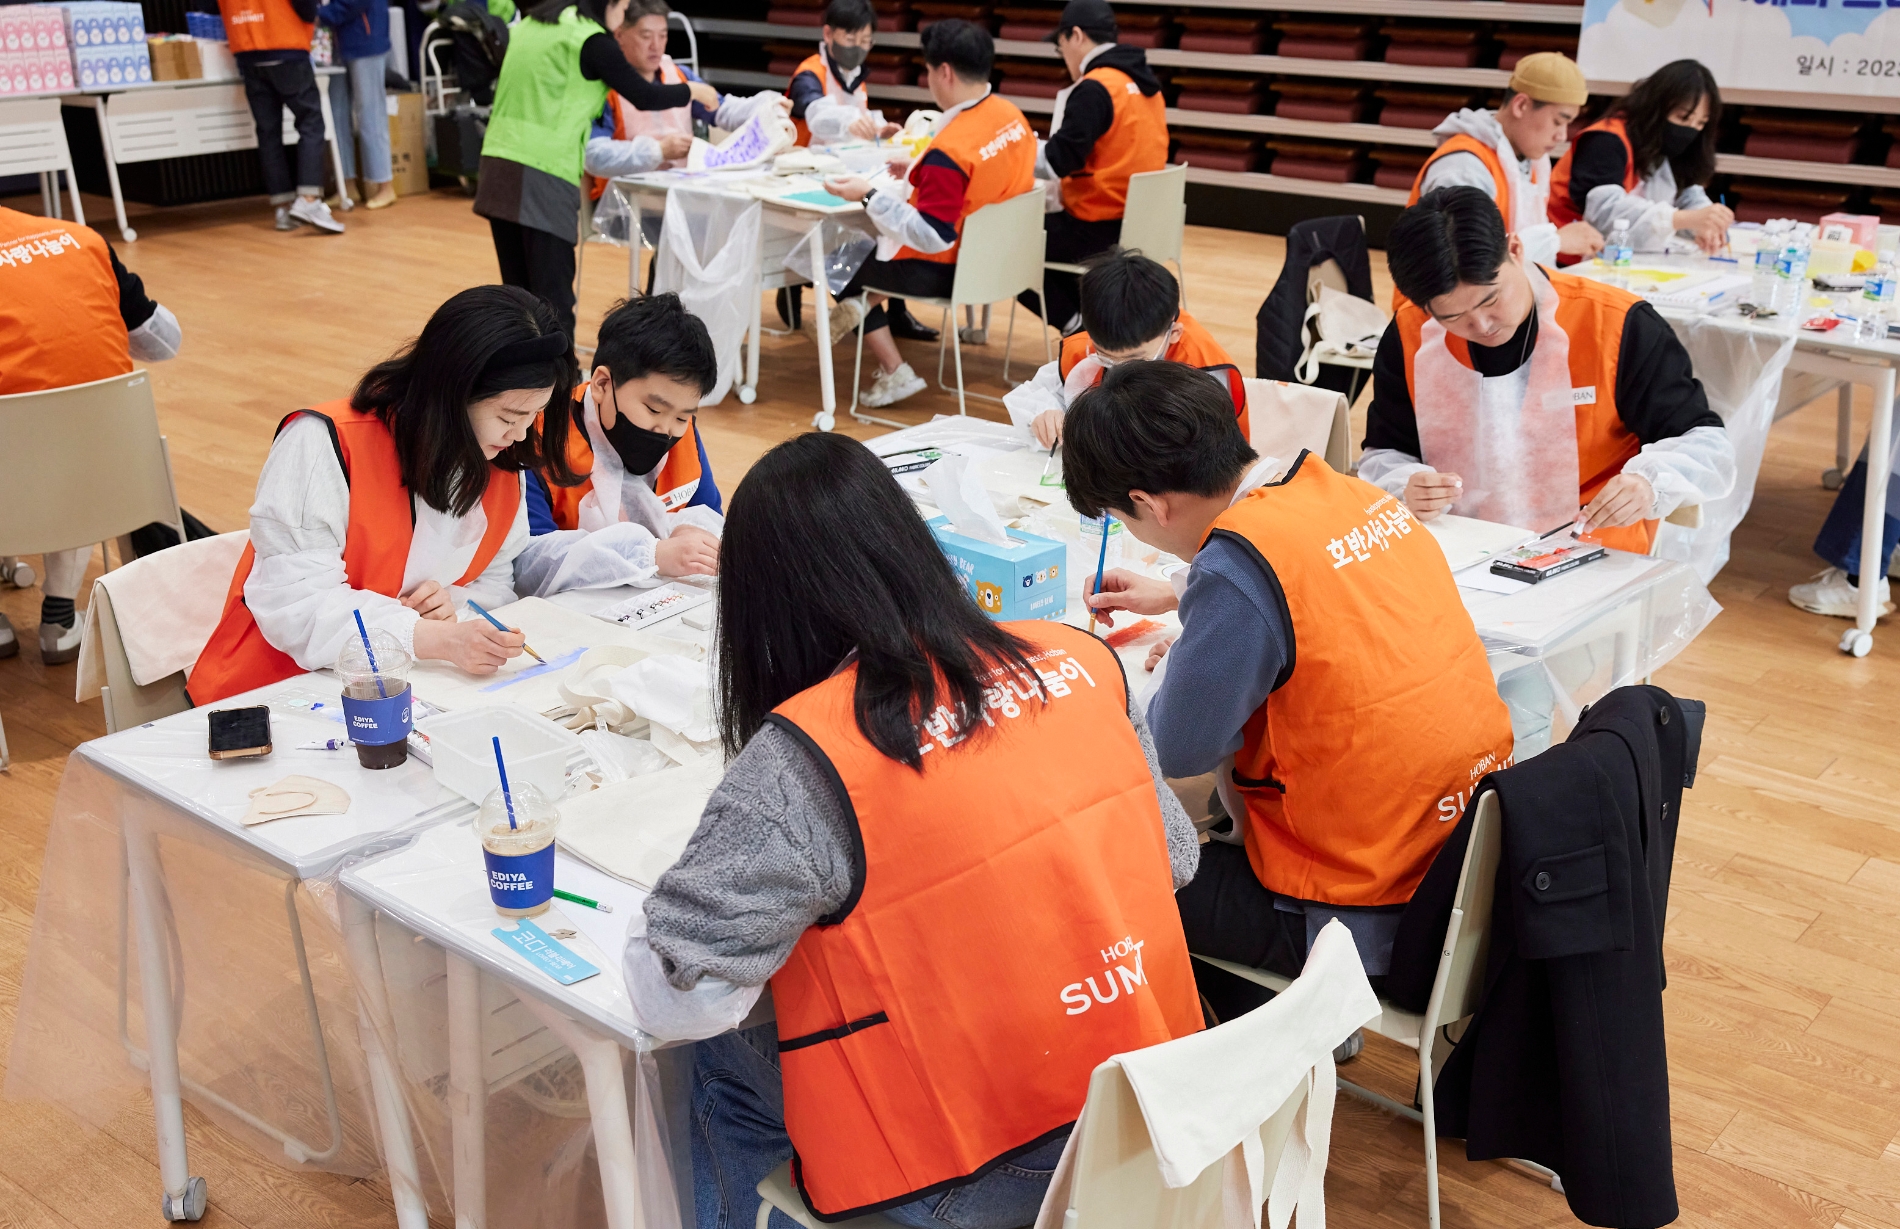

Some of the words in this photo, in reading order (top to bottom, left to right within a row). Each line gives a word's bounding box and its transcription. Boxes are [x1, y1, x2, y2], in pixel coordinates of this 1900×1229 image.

[1797, 55, 1834, 77] 일시
[1044, 648, 1068, 660] Hoban
[352, 721, 379, 729] COFFEE
[353, 715, 374, 723] EDIYA
[1469, 751, 1496, 780] HOBAN
[491, 870, 527, 882] EDIYA
[490, 878, 534, 891] COFFEE
[511, 930, 548, 953] 코디
